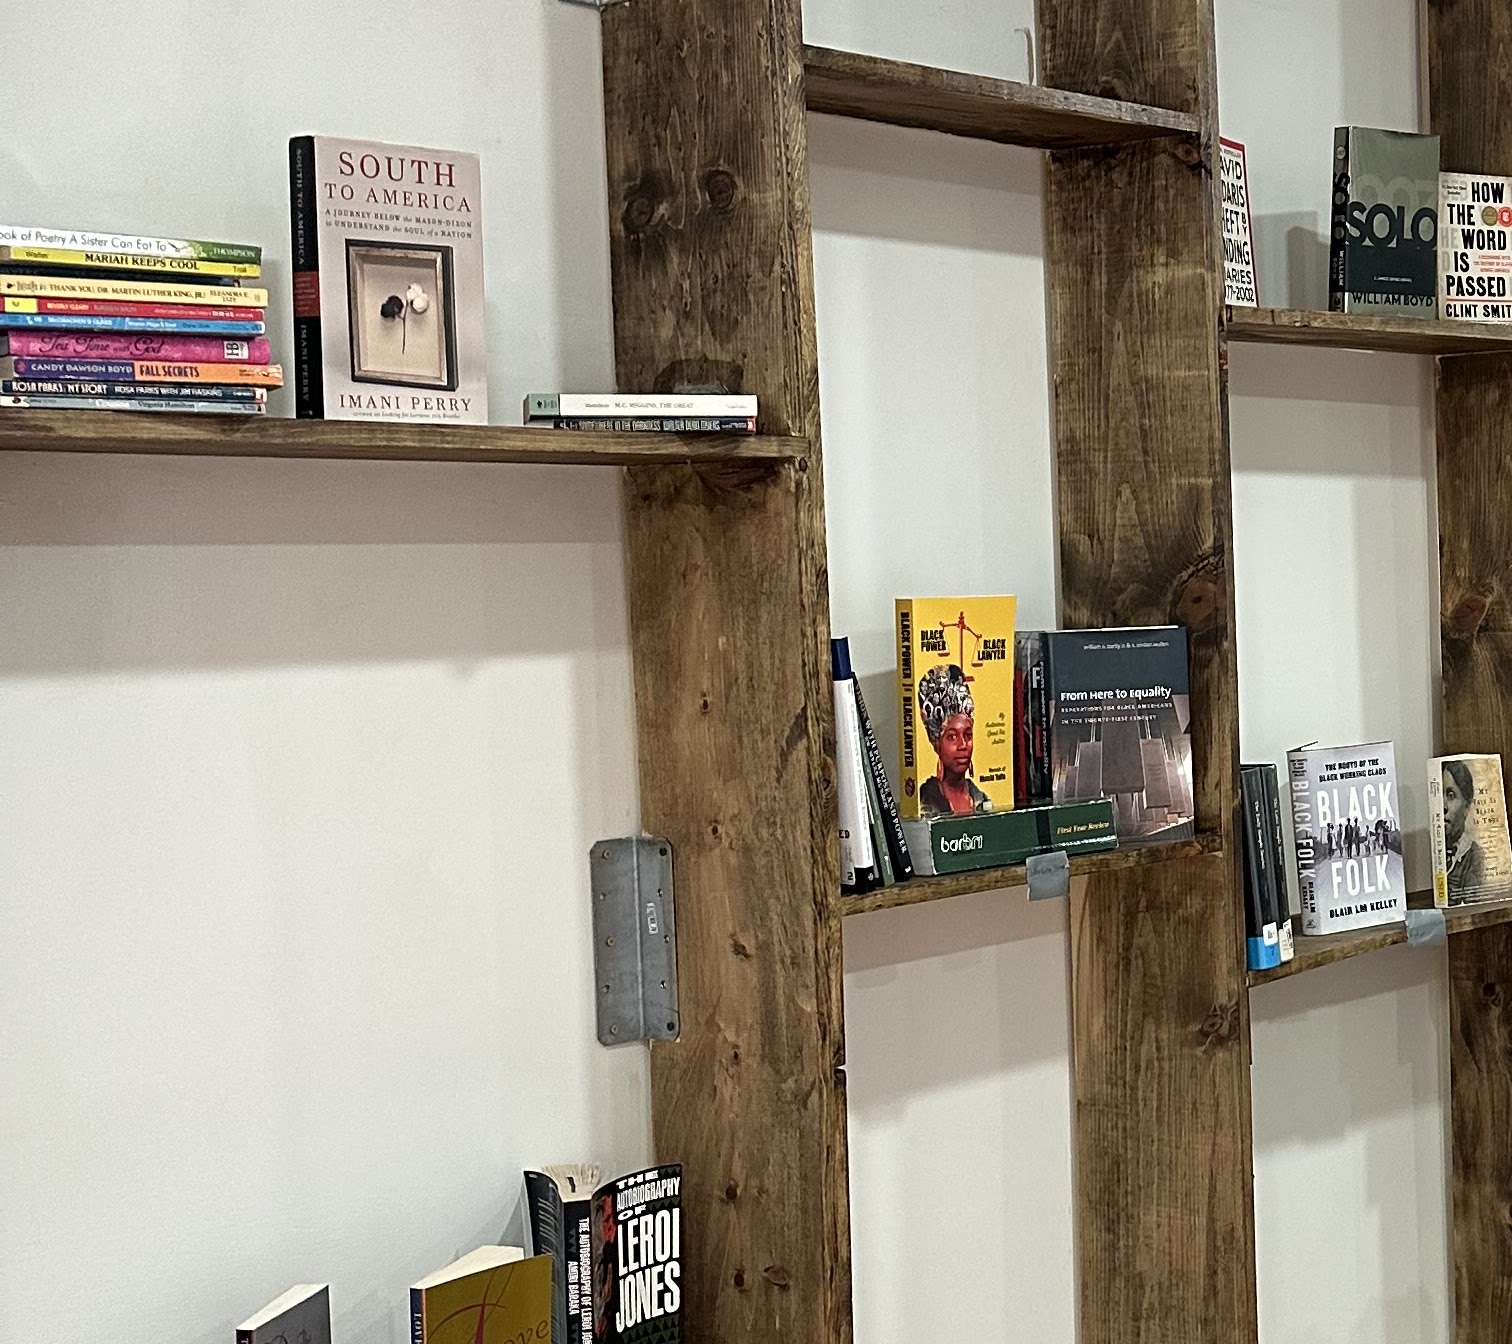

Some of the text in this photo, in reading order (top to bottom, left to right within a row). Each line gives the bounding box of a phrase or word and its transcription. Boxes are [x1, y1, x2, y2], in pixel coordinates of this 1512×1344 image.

[339, 151, 456, 188] SOUTH
[324, 183, 472, 213] TO AMERICA
[1471, 181, 1504, 204] HOW
[333, 209, 472, 228] JOURNEY BELOW MASON-DIXON
[1346, 200, 1438, 249] SOLO
[1447, 203, 1476, 226] THE
[36, 231, 153, 250] Poetry A Sister Can Eat
[335, 221, 472, 239] UNDERSTAND SOUL NATION
[1461, 228, 1507, 251] WORD
[85, 253, 200, 270] MARIAH KEEPS COOL
[213, 247, 255, 257] THOMPSON
[1454, 251, 1470, 273] IS
[1446, 274, 1506, 298] PASSED
[1352, 291, 1434, 307] WILLIAM BOYD
[1446, 303, 1478, 318] CLINT
[31, 363, 133, 373] CANDY DAWSON BOYD
[140, 365, 200, 377] FALL SECRETS
[12, 381, 36, 391] ROSA
[339, 394, 472, 412] IMANI PERRY
[901, 612, 912, 680] BLACK POWER
[921, 630, 944, 641] BLACK
[921, 640, 947, 652] POWER
[983, 638, 1006, 650] BLACK
[977, 648, 1006, 662] LAWYER
[1061, 685, 1171, 701] From Here to Equality
[902, 696, 914, 768] BLACK LAWYER
[1319, 767, 1387, 783] BLACK WORKING CLASS
[1325, 758, 1379, 772] THE ROOTS THE
[1316, 781, 1394, 828] BLACK
[1292, 781, 1316, 879] BLACK FOLK
[1331, 854, 1391, 899] FOLK
[1329, 898, 1397, 919] BLAIR KELLEY
[615, 1169, 659, 1190] THE
[616, 1176, 681, 1212] AUTOBIOGRAPHY
[617, 1204, 647, 1221] OF
[617, 1207, 680, 1278] LEROI
[578, 1233, 592, 1298] AUTOBIOGRAPHY
[568, 1288, 580, 1316] BARAKA
[615, 1260, 681, 1334] JONES
